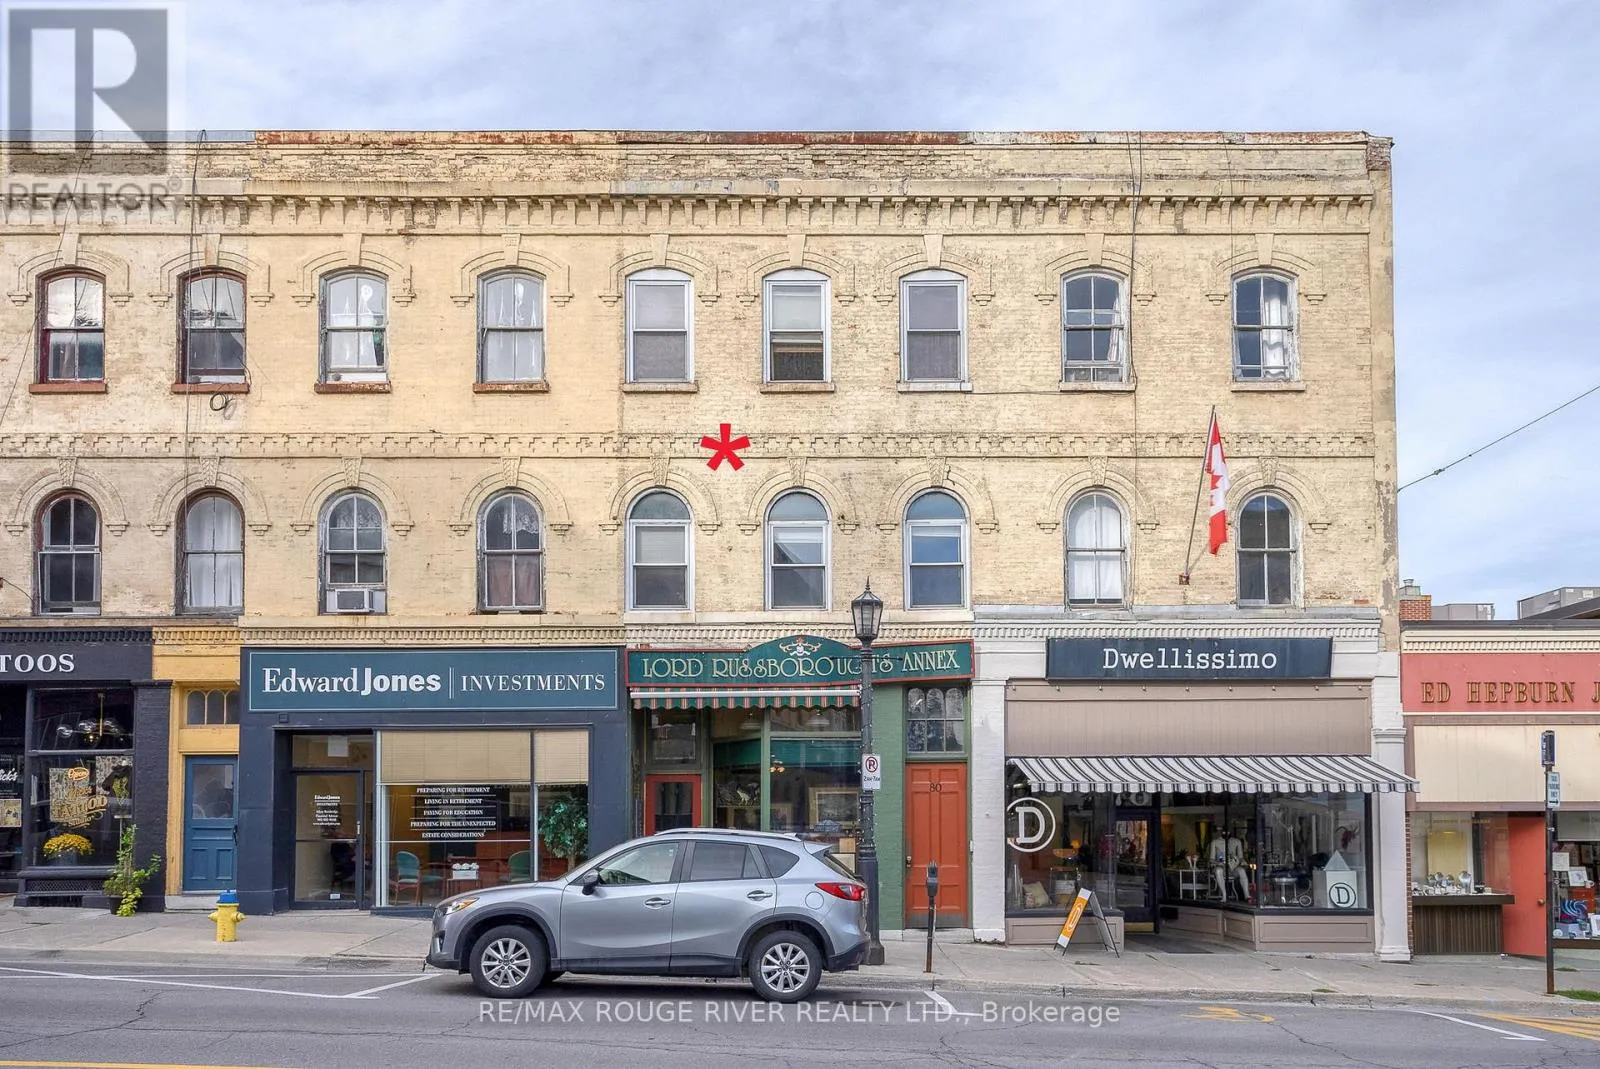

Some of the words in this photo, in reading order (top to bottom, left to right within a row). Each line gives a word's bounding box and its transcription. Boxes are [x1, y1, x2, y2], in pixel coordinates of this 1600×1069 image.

[641, 658, 704, 678] LORD
[901, 649, 961, 672] ANNEX
[1102, 648, 1278, 670] Dwellissimo
[461, 674, 607, 692] INVESTMENTS
[1421, 681, 1451, 703] ED
[1466, 681, 1576, 703] HEPBURN
[1015, 806, 1046, 844] D
[1335, 886, 1350, 904] D
